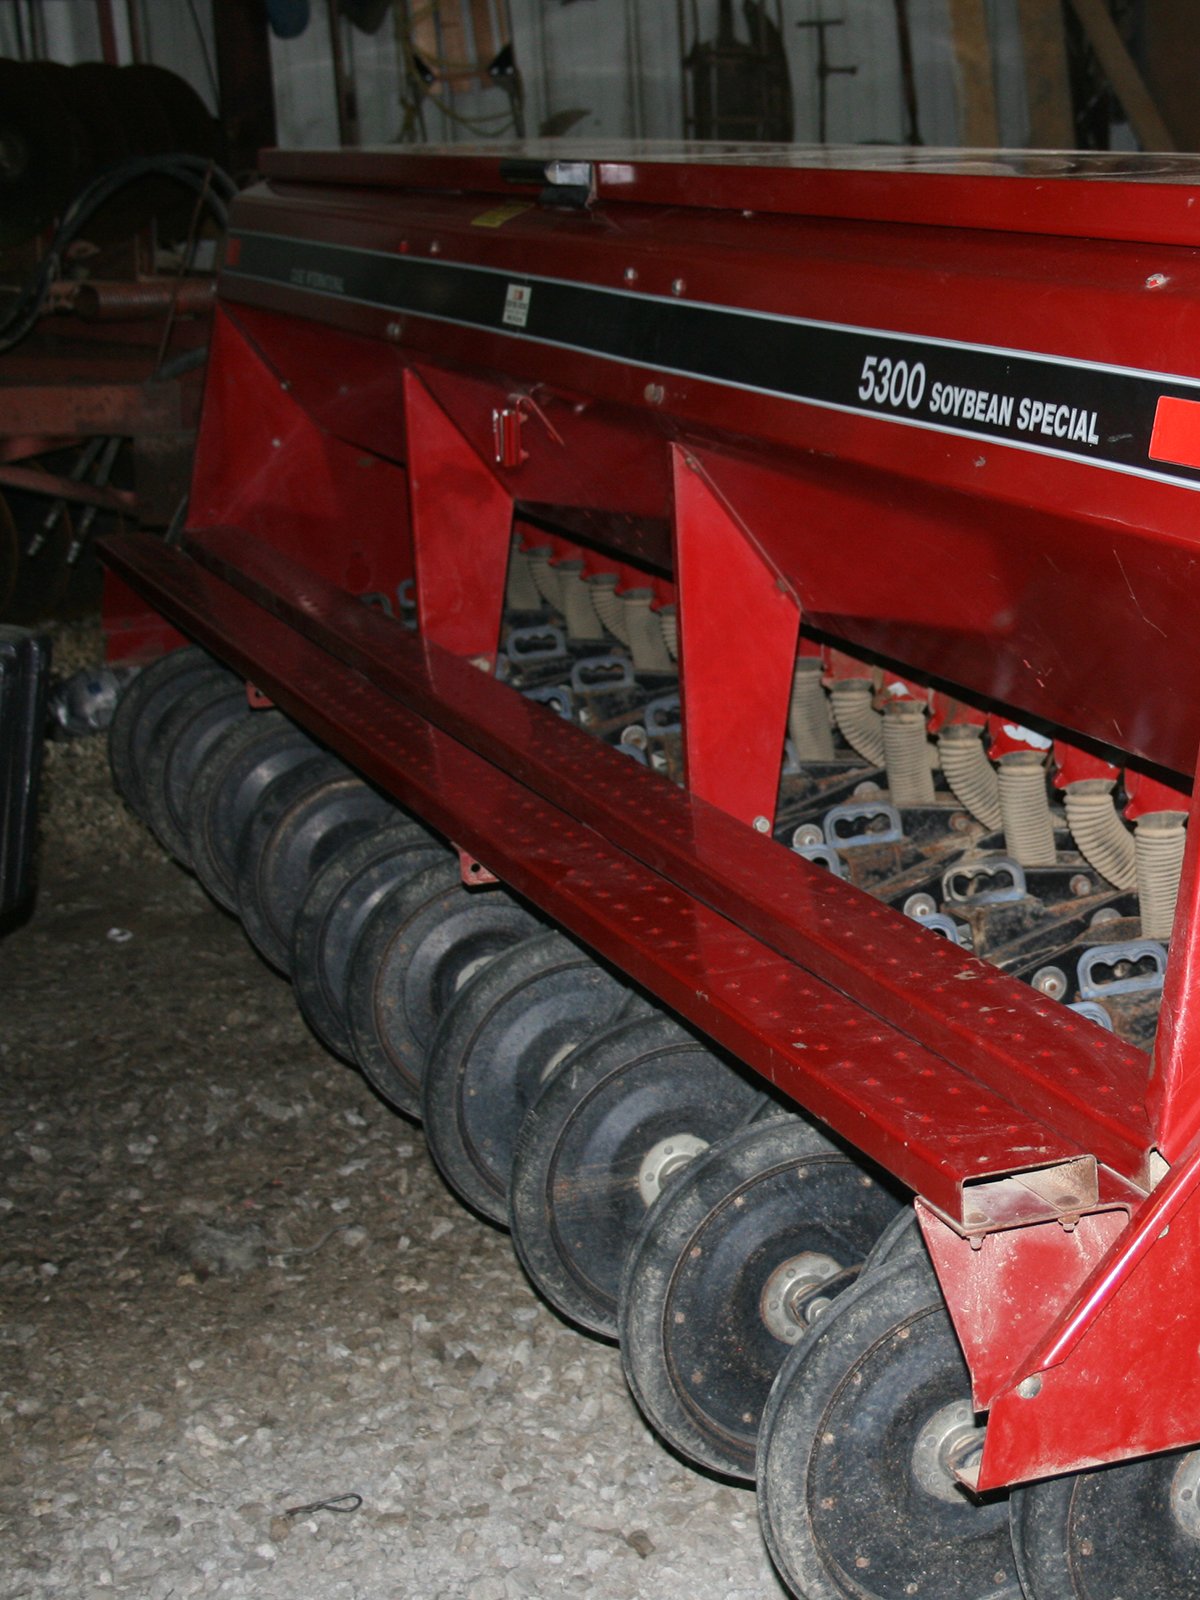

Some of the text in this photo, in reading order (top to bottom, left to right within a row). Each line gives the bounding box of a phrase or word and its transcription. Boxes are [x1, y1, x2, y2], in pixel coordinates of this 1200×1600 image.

[858, 355, 1100, 446] 5300 SOYBEAN SPECIAL
